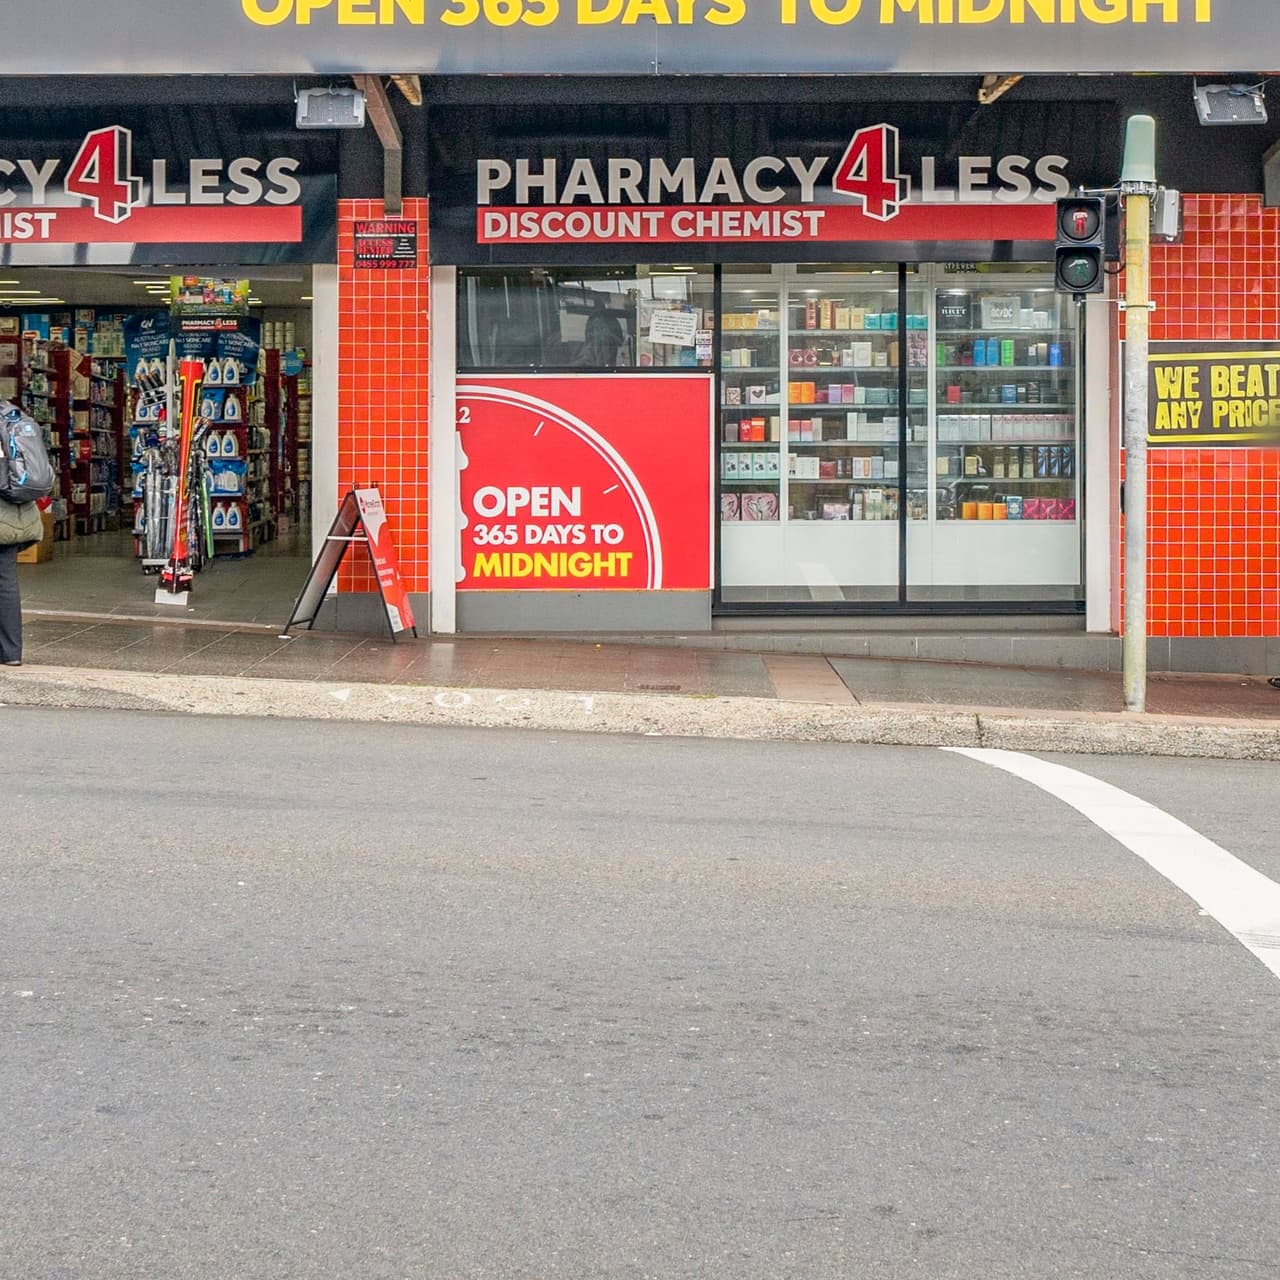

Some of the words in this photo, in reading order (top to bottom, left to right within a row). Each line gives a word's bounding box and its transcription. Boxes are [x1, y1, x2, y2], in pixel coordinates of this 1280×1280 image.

[65, 125, 143, 224] 4
[152, 157, 302, 205] LESS
[476, 156, 829, 205] PHARMACY
[832, 122, 910, 222] 4
[921, 154, 1070, 202] LESS
[356, 223, 416, 234] WARNING
[483, 210, 667, 239] DISCOUNT
[670, 209, 826, 238] CHEMIST
[1154, 366, 1200, 400] WE
[1210, 363, 1280, 399] BEAT
[1154, 401, 1202, 431] ANY
[472, 486, 582, 518] OPEN
[472, 524, 519, 546] 365
[524, 524, 586, 546] DAYS
[591, 524, 625, 546] TO
[472, 552, 633, 578] MIDNIGHT
